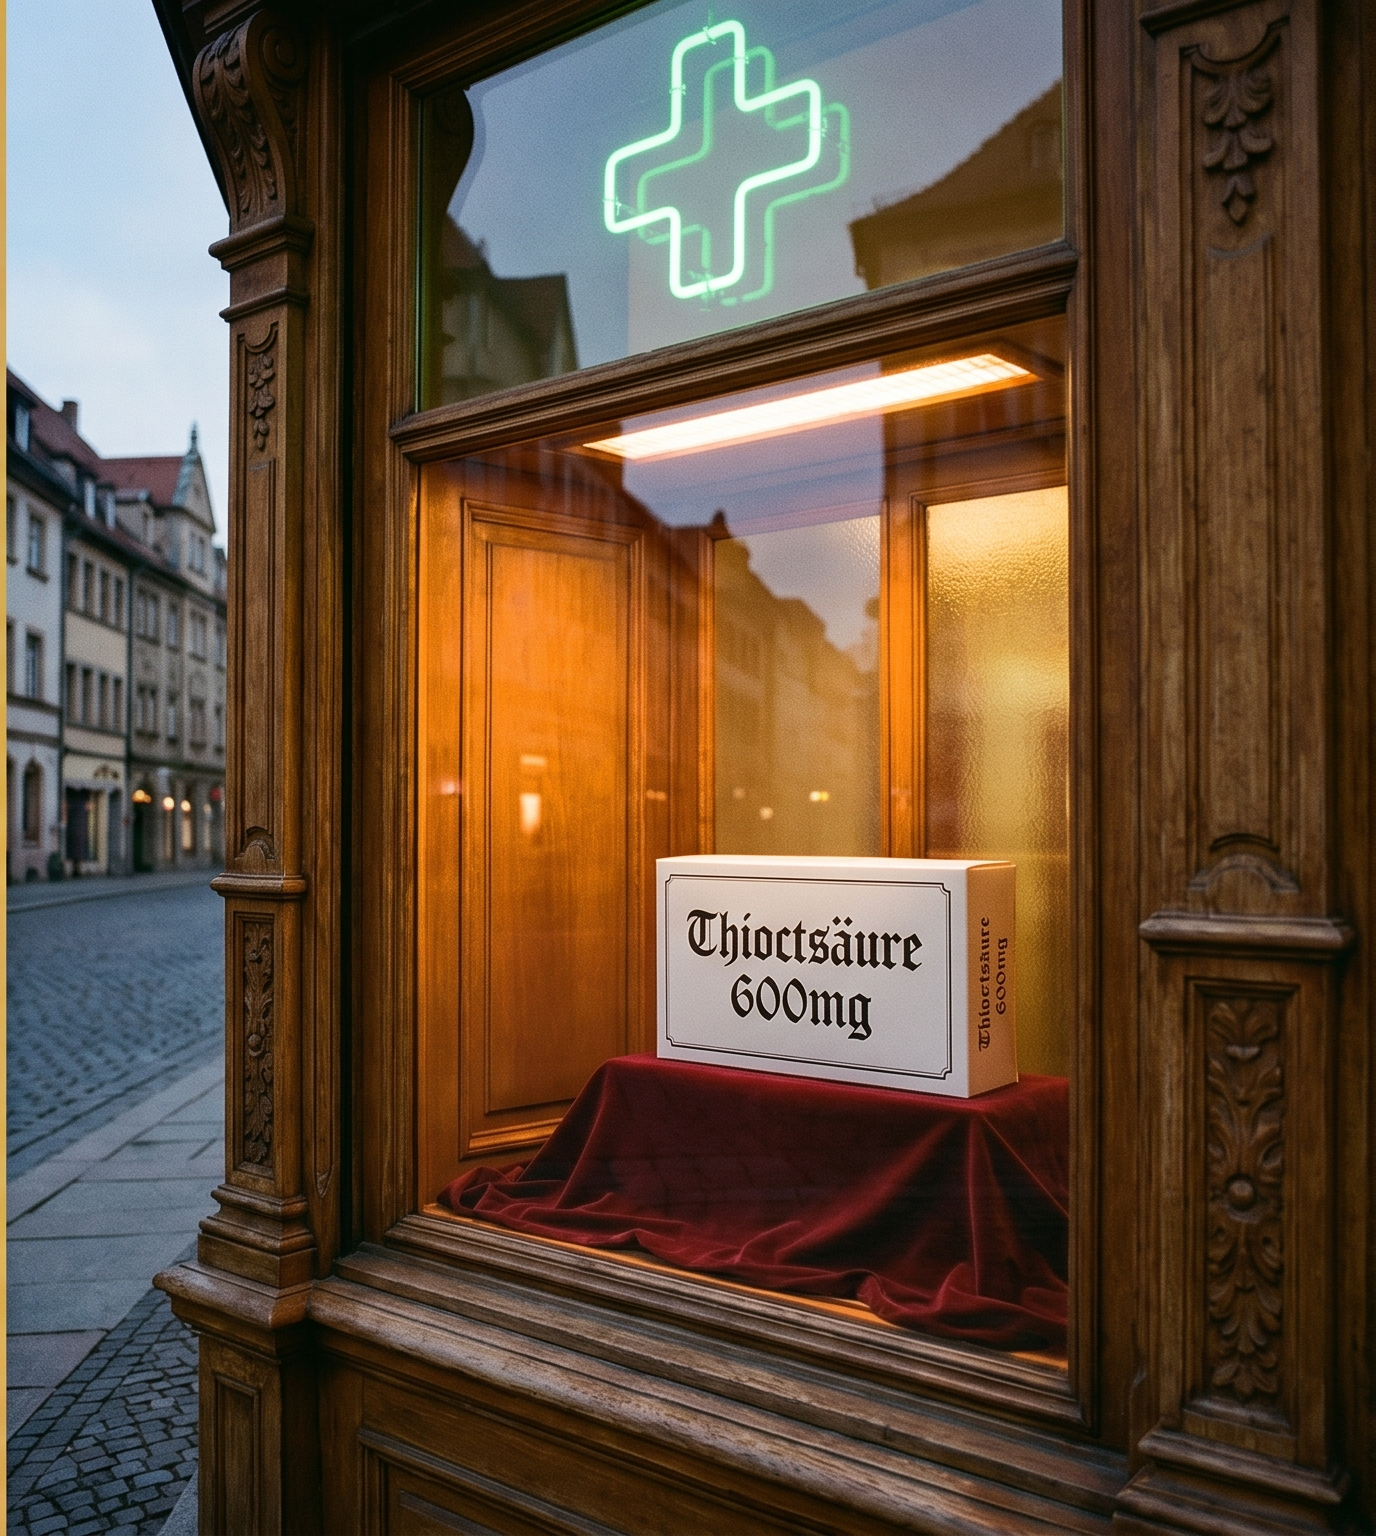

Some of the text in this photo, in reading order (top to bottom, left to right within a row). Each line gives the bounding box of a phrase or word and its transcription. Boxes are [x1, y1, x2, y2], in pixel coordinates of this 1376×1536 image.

[686, 909, 923, 972] Thioctsäure
[995, 937, 1008, 1016] 600mg
[730, 973, 873, 1041] 600mg
[979, 916, 991, 1053] Thioctsäure
